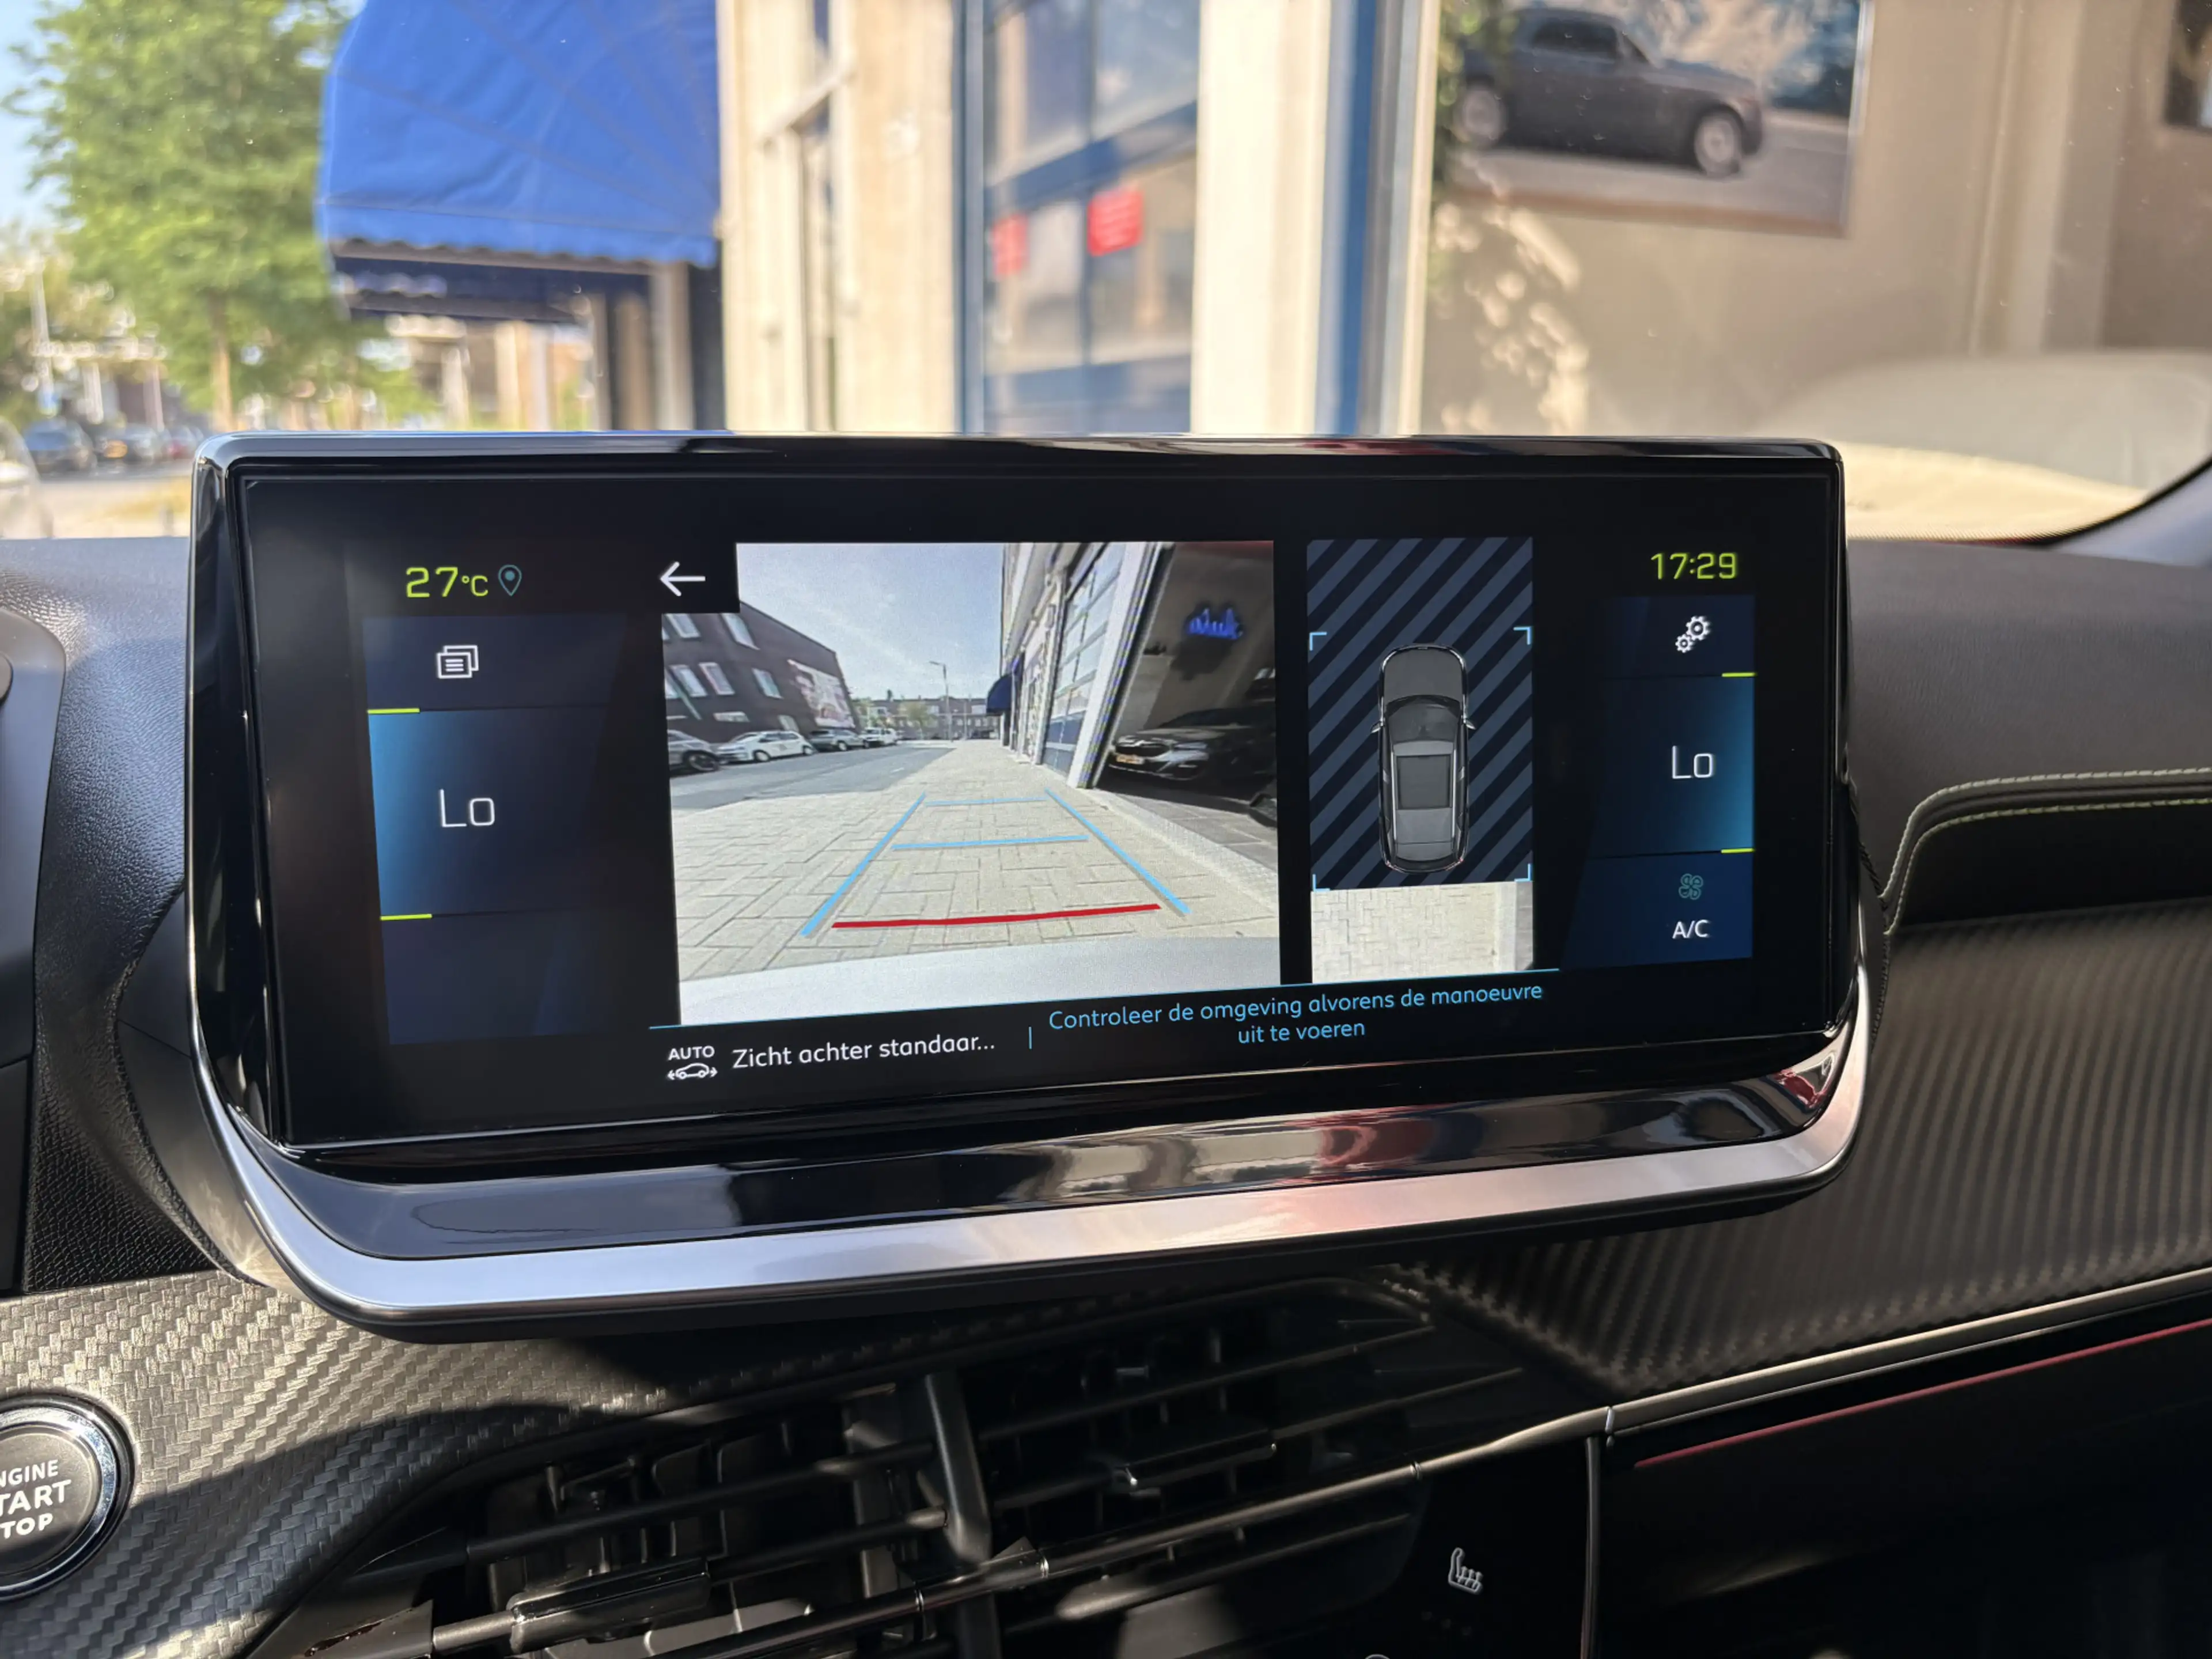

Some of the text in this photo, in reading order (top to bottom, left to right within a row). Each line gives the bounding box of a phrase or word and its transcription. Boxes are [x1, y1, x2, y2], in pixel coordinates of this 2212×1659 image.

[1650, 552, 1740, 580] 17:29
[1672, 745, 1714, 780] Lo
[438, 788, 495, 828] Lo
[1672, 918, 1710, 940] A/C
[1048, 985, 1543, 1031] Controleer de omgeving alvorens de manoeuvre
[1238, 1022, 1366, 1044] uit te voeren
[667, 1044, 715, 1061] AUTO
[732, 1033, 995, 1069] Zicht achter standaar...
